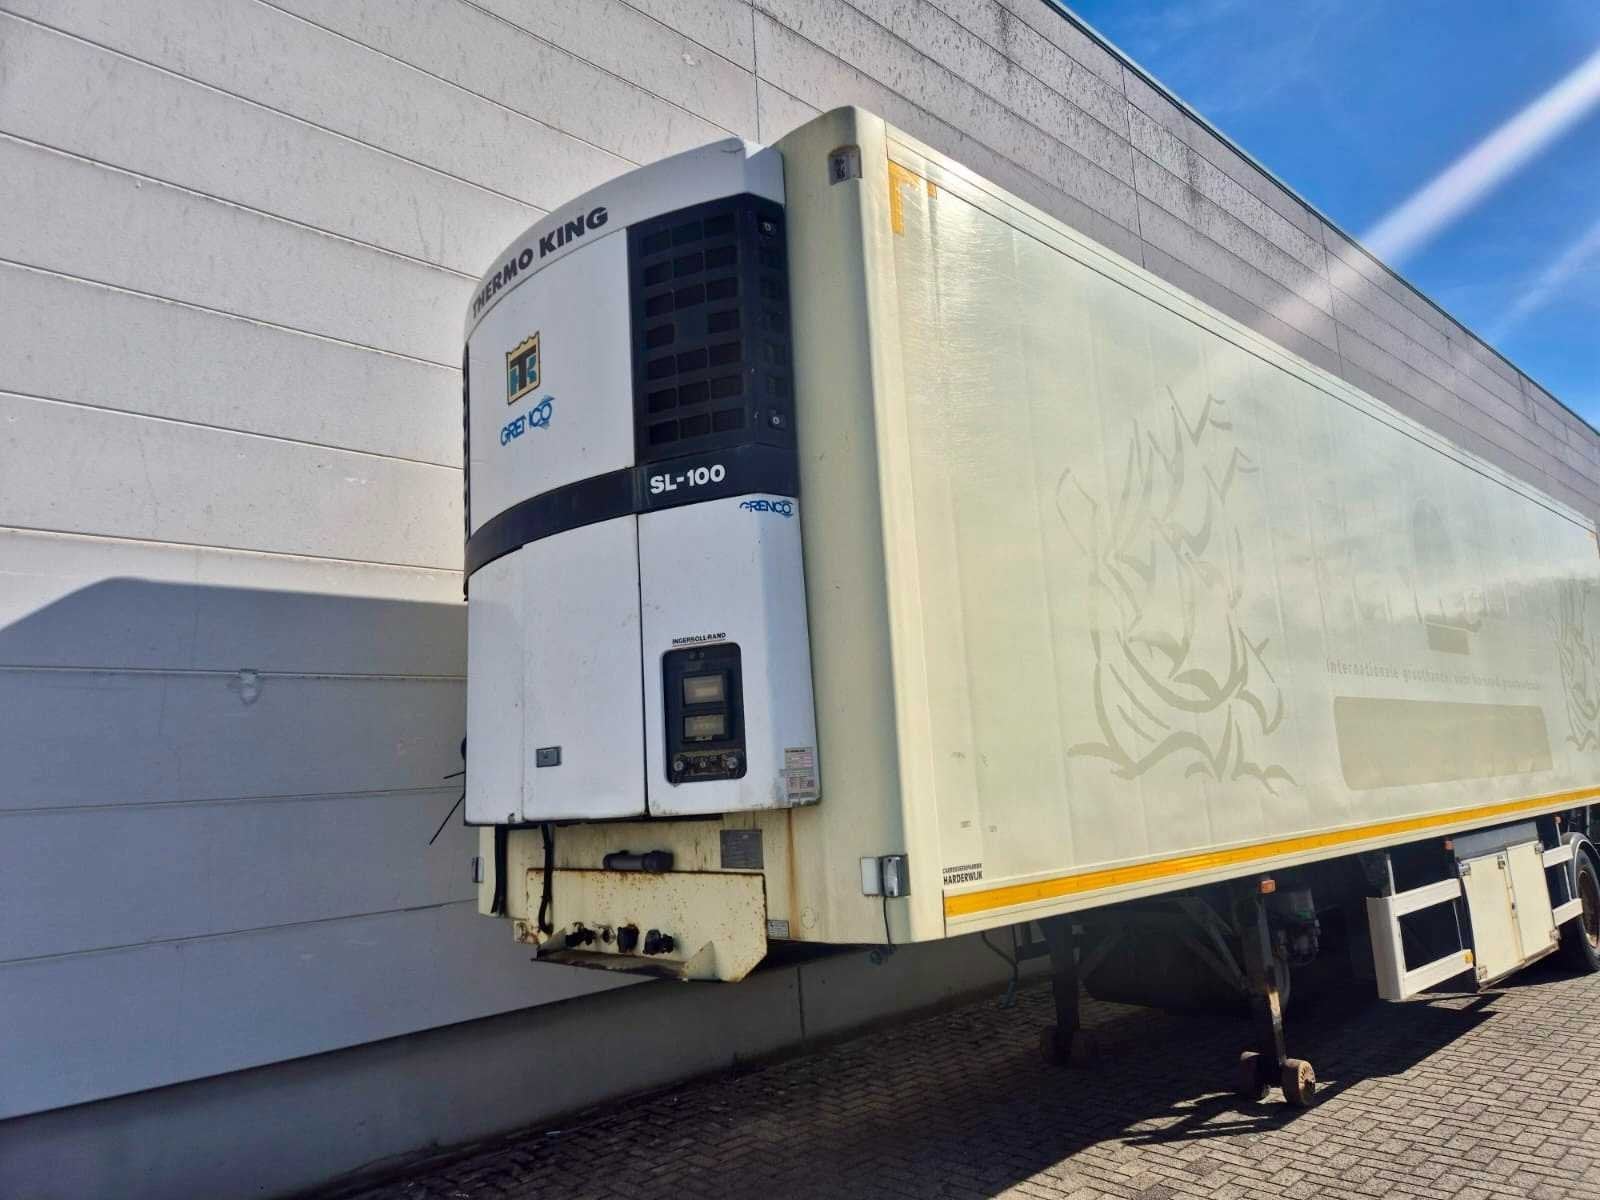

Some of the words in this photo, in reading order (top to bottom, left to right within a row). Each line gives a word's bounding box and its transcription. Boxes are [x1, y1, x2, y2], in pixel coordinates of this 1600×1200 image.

[473, 247, 534, 319] THERMO
[539, 206, 608, 258] KING
[650, 464, 726, 494] SL-100
